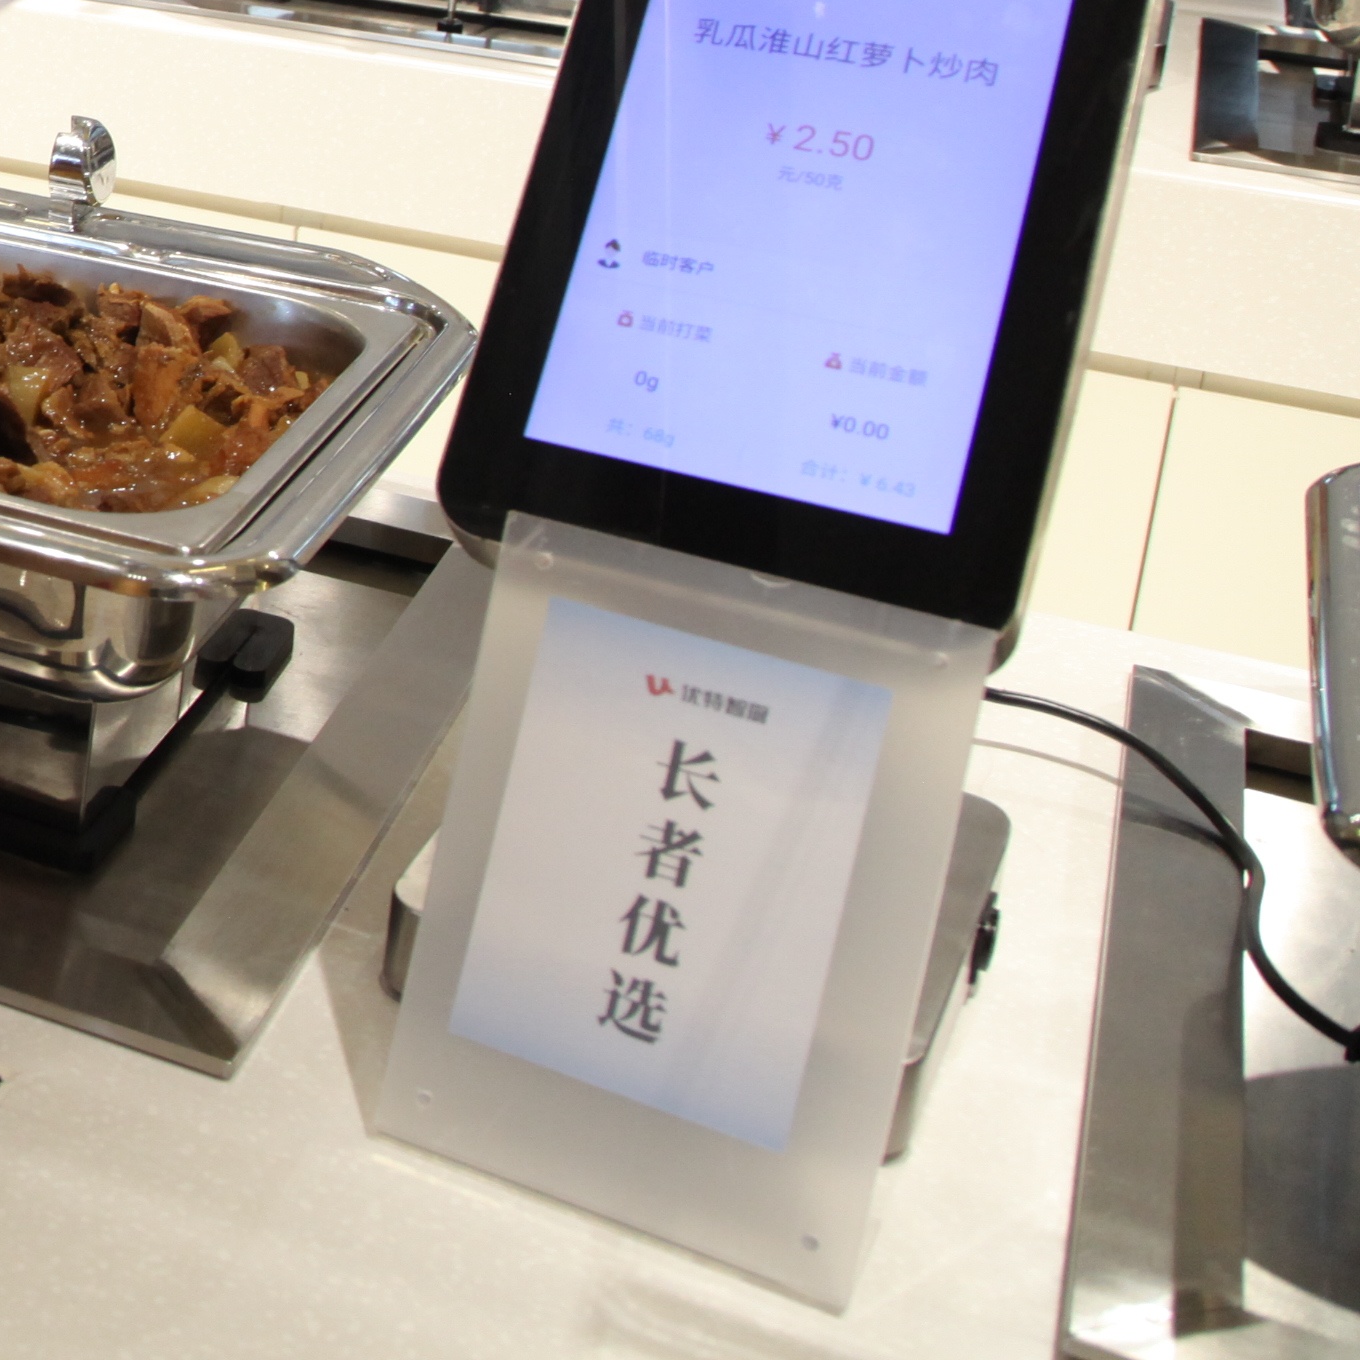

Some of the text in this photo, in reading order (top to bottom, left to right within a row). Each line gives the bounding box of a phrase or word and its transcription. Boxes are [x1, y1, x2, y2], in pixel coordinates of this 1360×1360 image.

[694, 17, 1000, 87] 乳瓜淮山红萝卜炒肉
[634, 370, 659, 392] 0g
[830, 412, 890, 441] ¥0.00
[595, 738, 723, 1045] 长者优选
